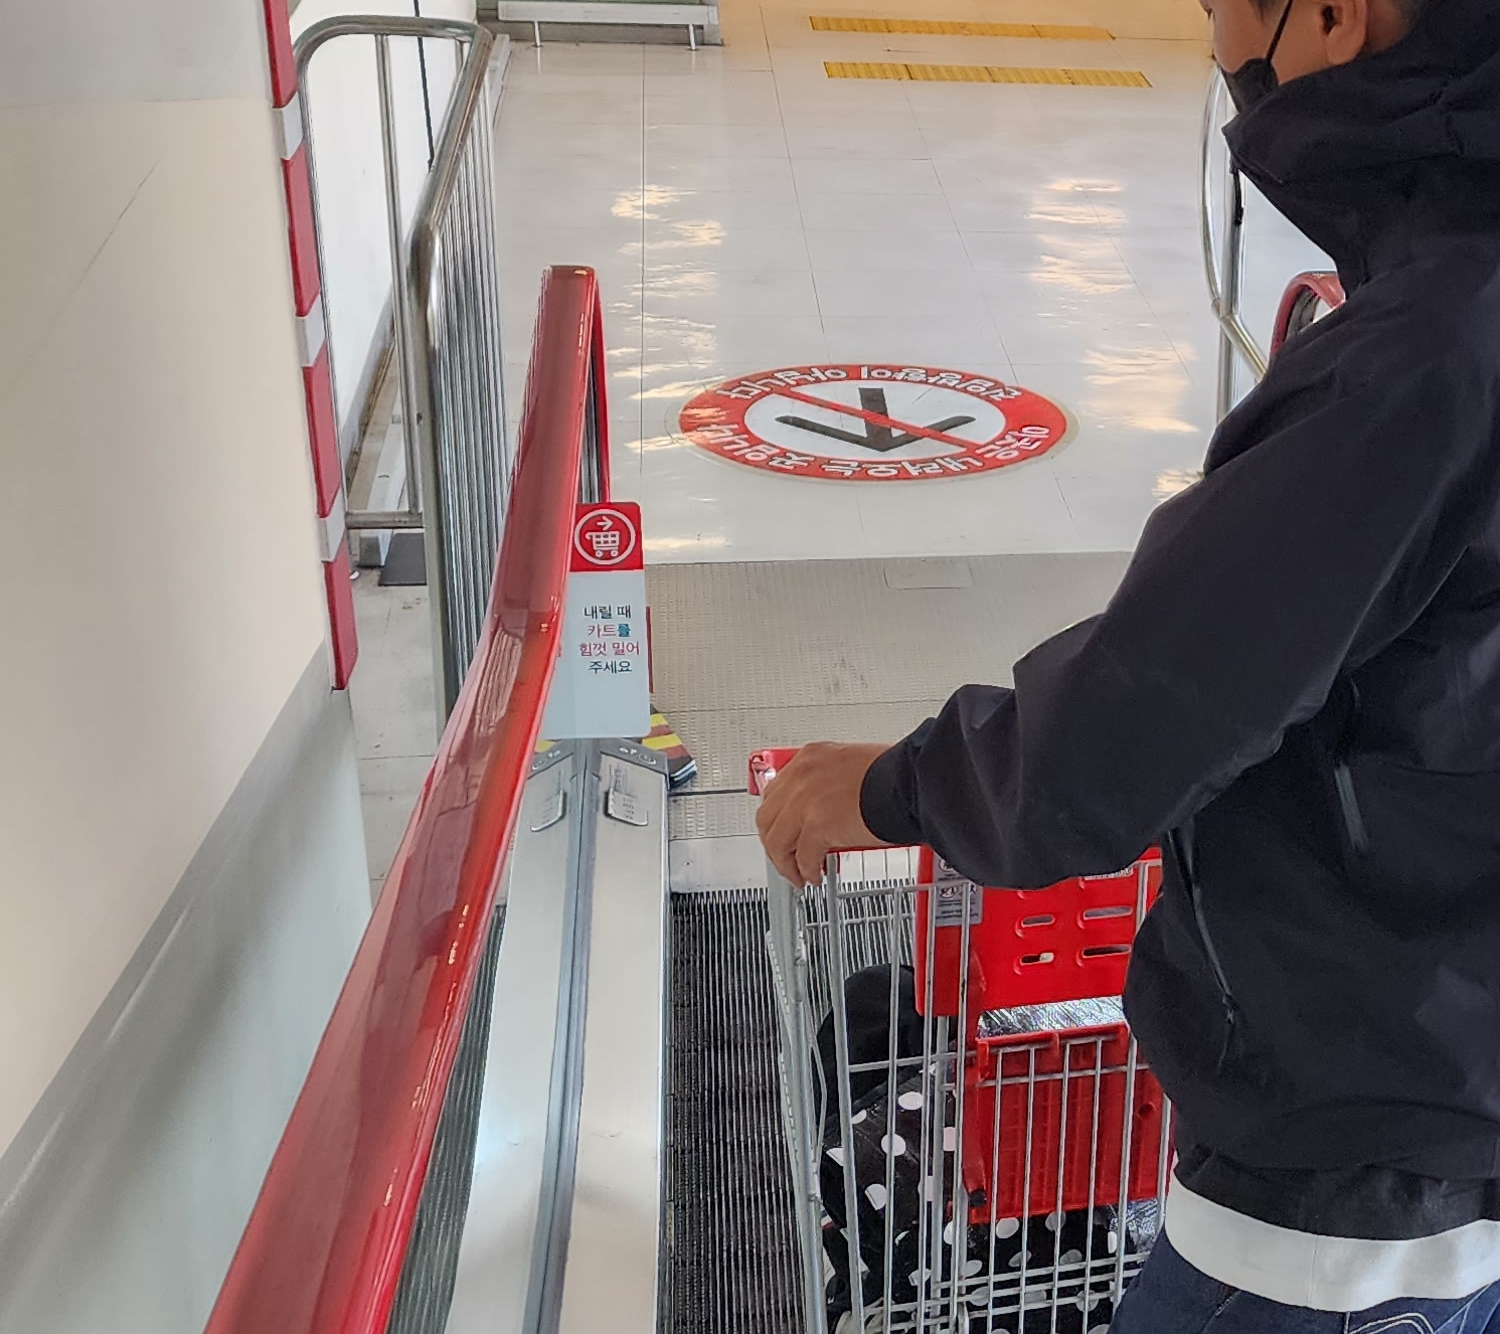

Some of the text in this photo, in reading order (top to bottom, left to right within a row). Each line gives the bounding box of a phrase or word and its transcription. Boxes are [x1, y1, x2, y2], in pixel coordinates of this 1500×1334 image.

[716, 366, 1022, 402] 진입방향이 아닙니다
[697, 424, 1050, 478] 이곳은 내려오는 곳입니다
[584, 605, 631, 619] 내릴 때
[587, 623, 631, 638] 카트를
[579, 642, 607, 656] 힘껏
[612, 641, 640, 656] 밀어
[588, 660, 632, 674] 주세요
